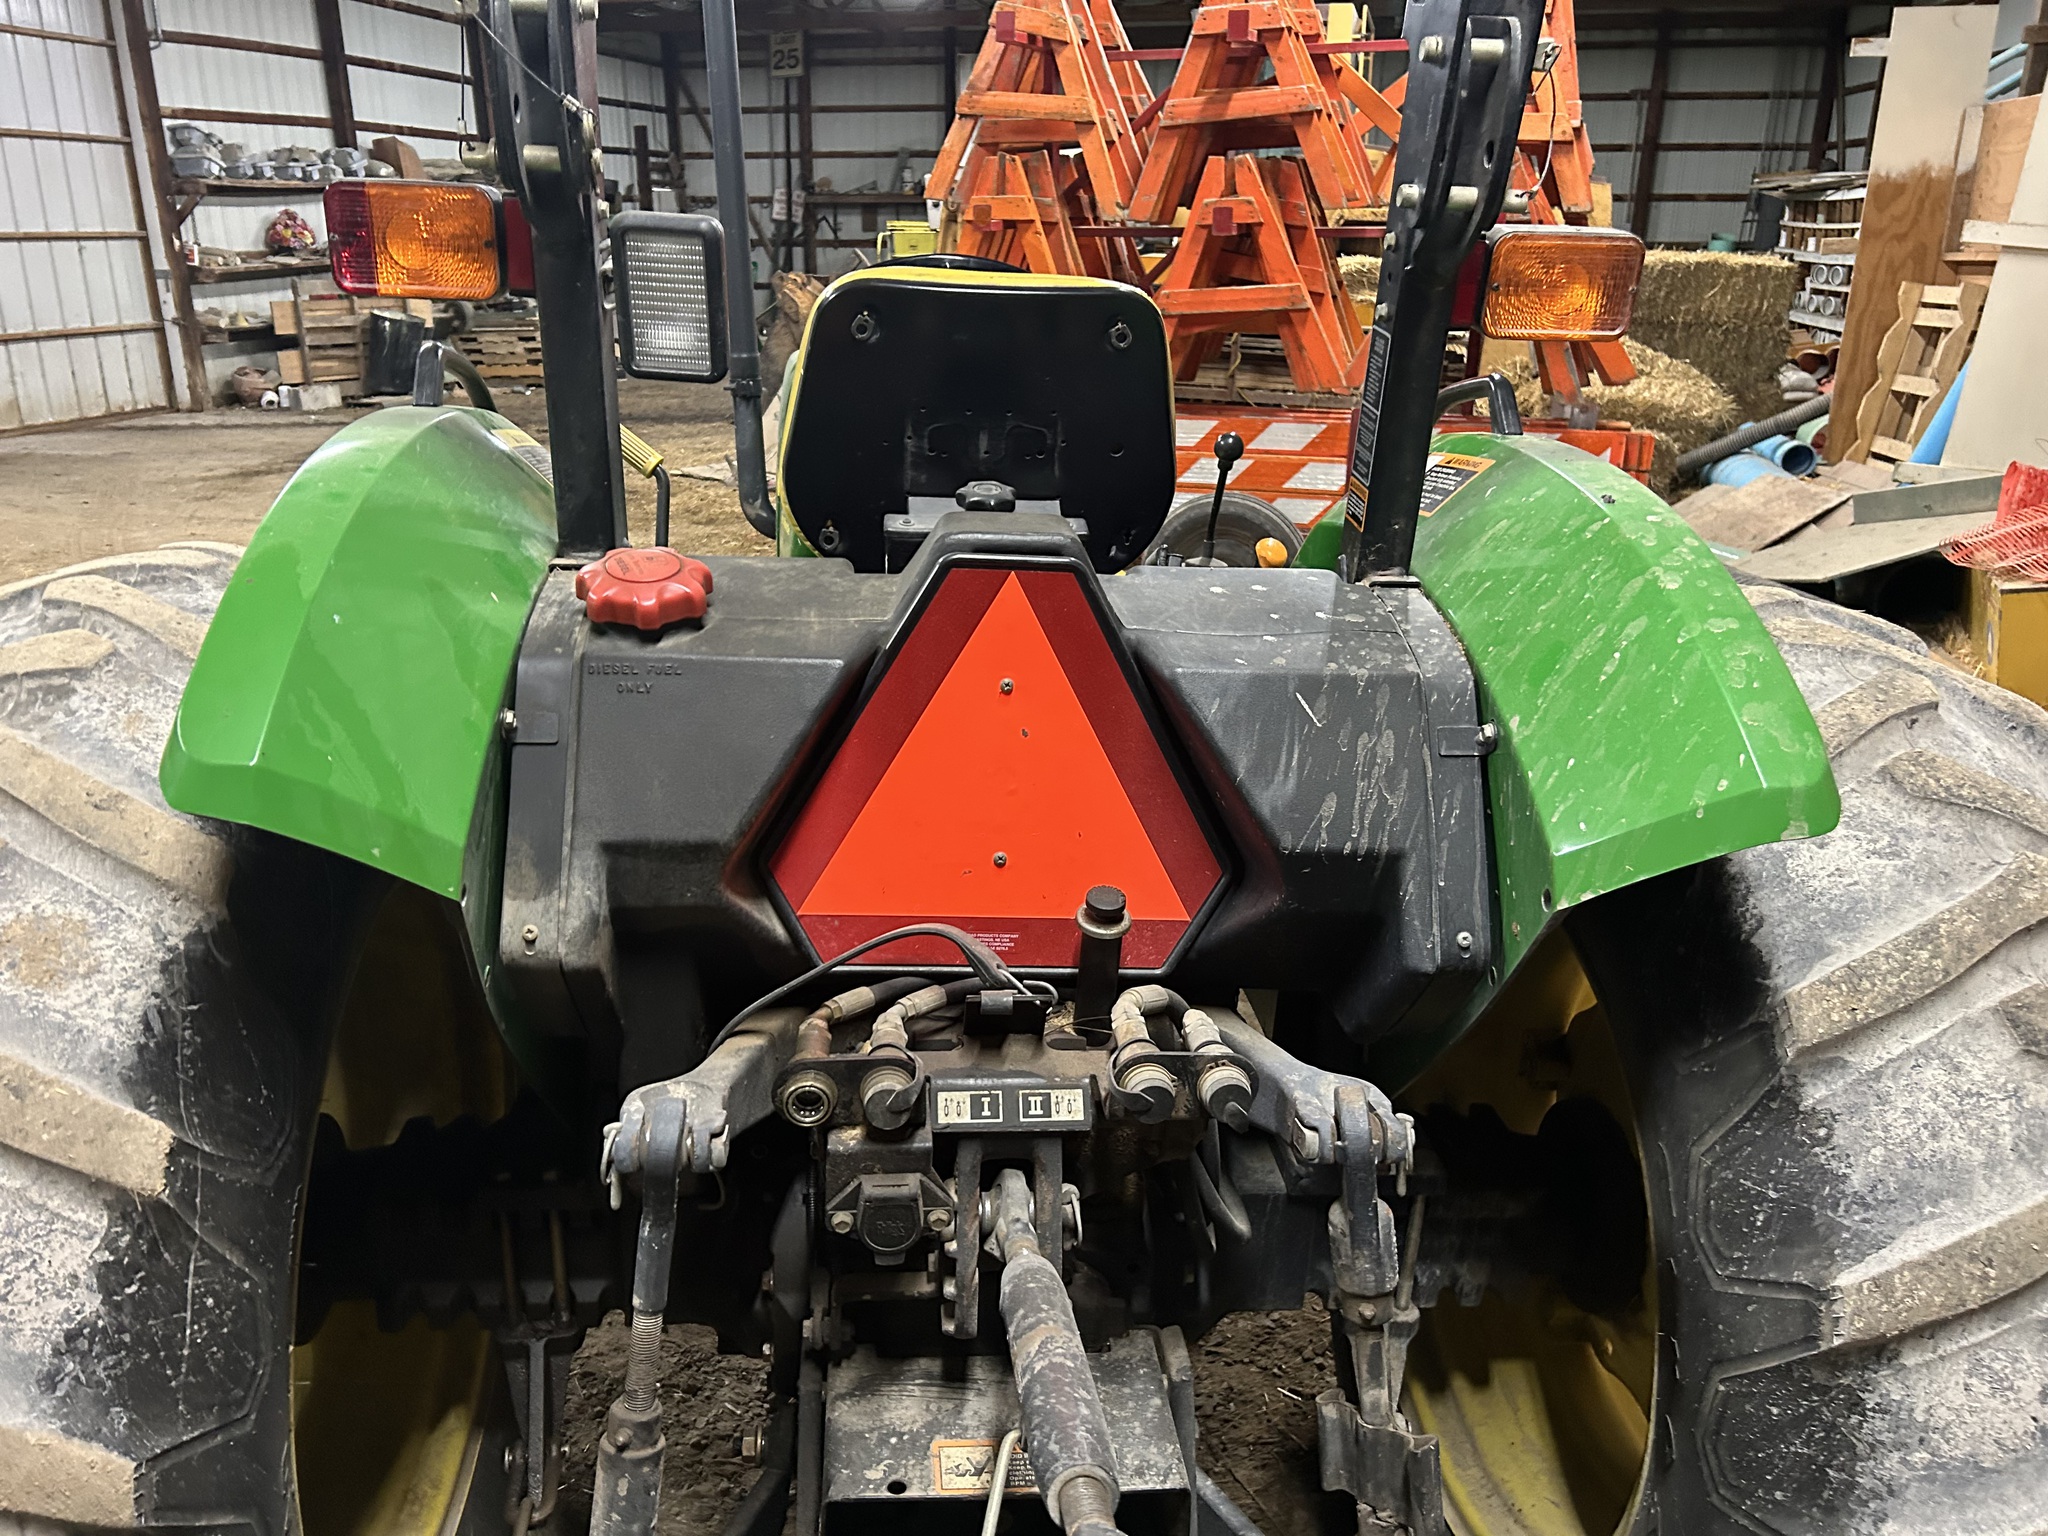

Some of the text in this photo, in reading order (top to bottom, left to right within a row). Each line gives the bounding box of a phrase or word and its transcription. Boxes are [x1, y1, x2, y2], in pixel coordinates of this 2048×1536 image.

[773, 48, 800, 70] 25
[588, 662, 682, 675] DIESEL FUEL
[616, 681, 654, 694] ONLY
[981, 1096, 1043, 1116] I II
